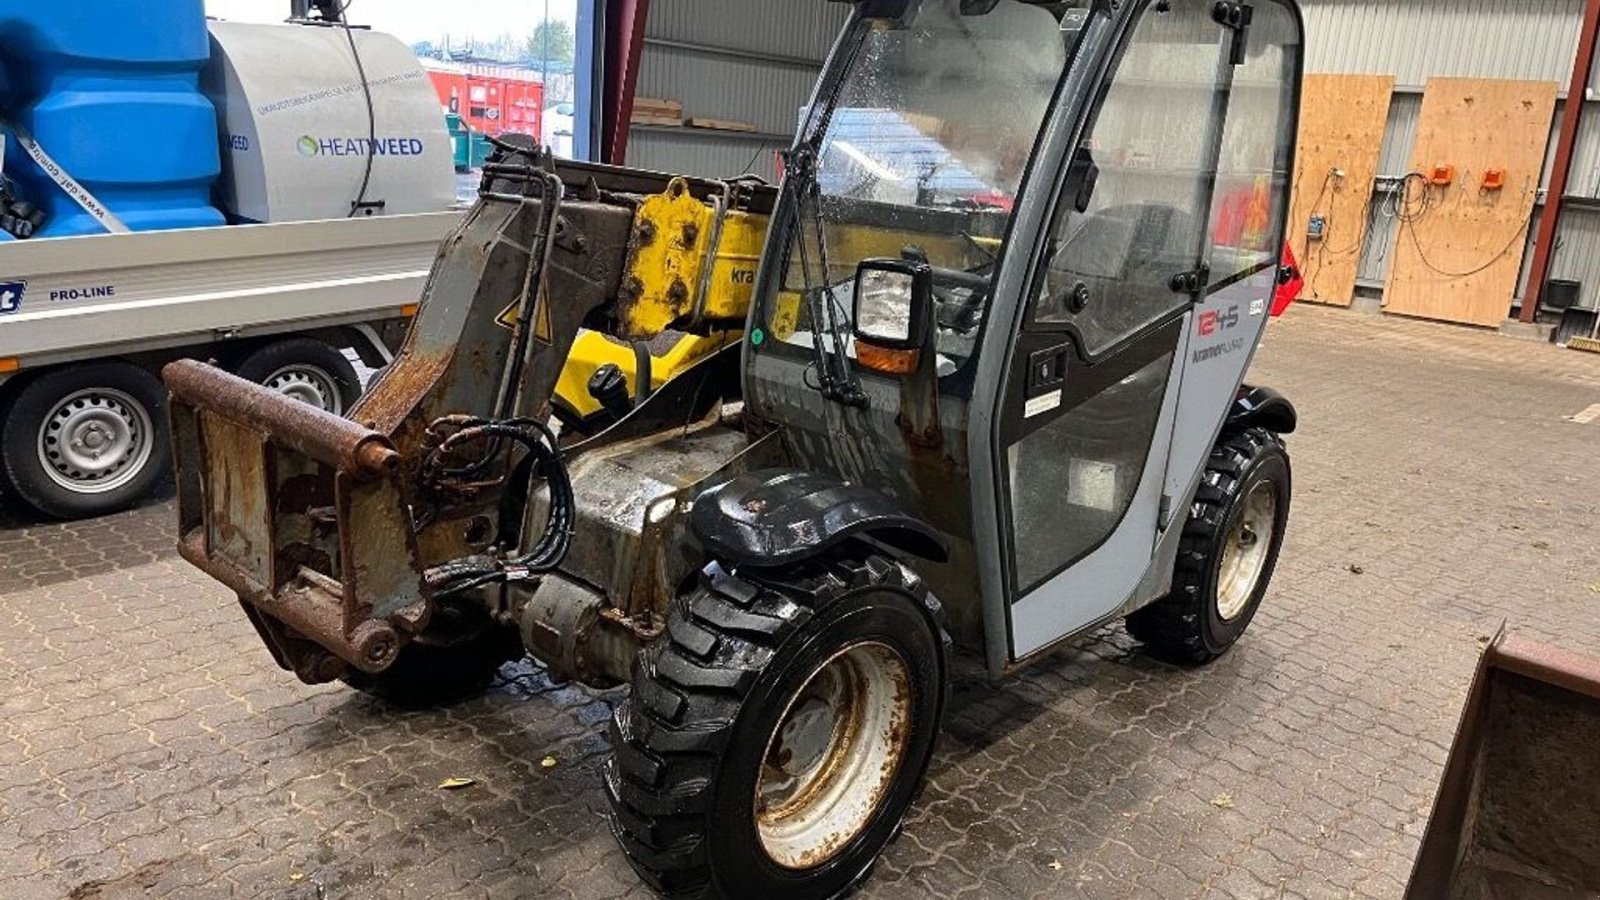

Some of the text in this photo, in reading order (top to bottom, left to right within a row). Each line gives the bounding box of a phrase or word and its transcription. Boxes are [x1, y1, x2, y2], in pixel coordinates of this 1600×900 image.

[319, 138, 423, 156] HEATWEED
[731, 266, 757, 284] kra
[50, 286, 115, 301] PRO-LINE
